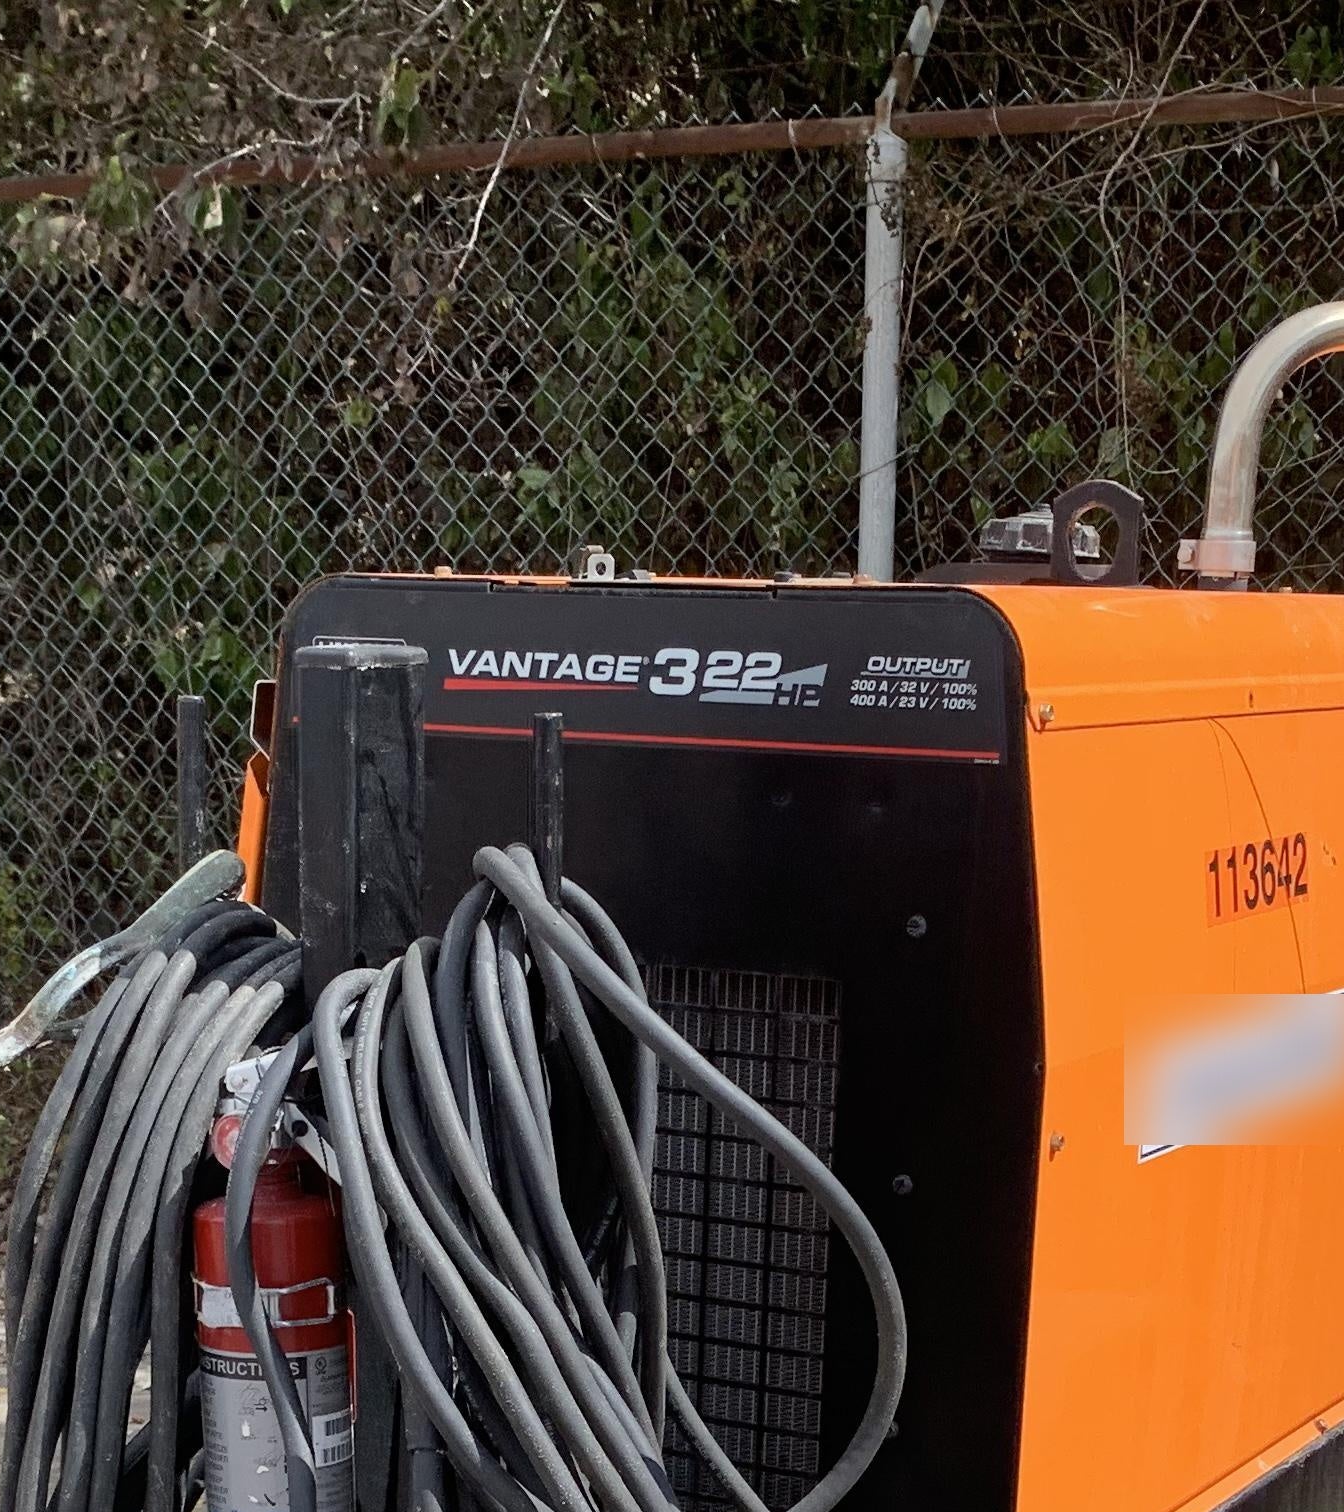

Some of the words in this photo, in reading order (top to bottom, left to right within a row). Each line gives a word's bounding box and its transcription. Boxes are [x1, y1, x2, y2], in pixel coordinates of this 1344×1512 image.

[447, 649, 643, 683] VANTAGE
[649, 648, 783, 697] 322
[867, 656, 965, 675] OUTPUT
[850, 679, 877, 692] 300
[899, 681, 917, 693] 32
[942, 683, 978, 696] 100%
[850, 694, 876, 707] 400
[898, 696, 917, 708] 23
[942, 698, 977, 711] 100%
[1208, 833, 1309, 918] 113642
